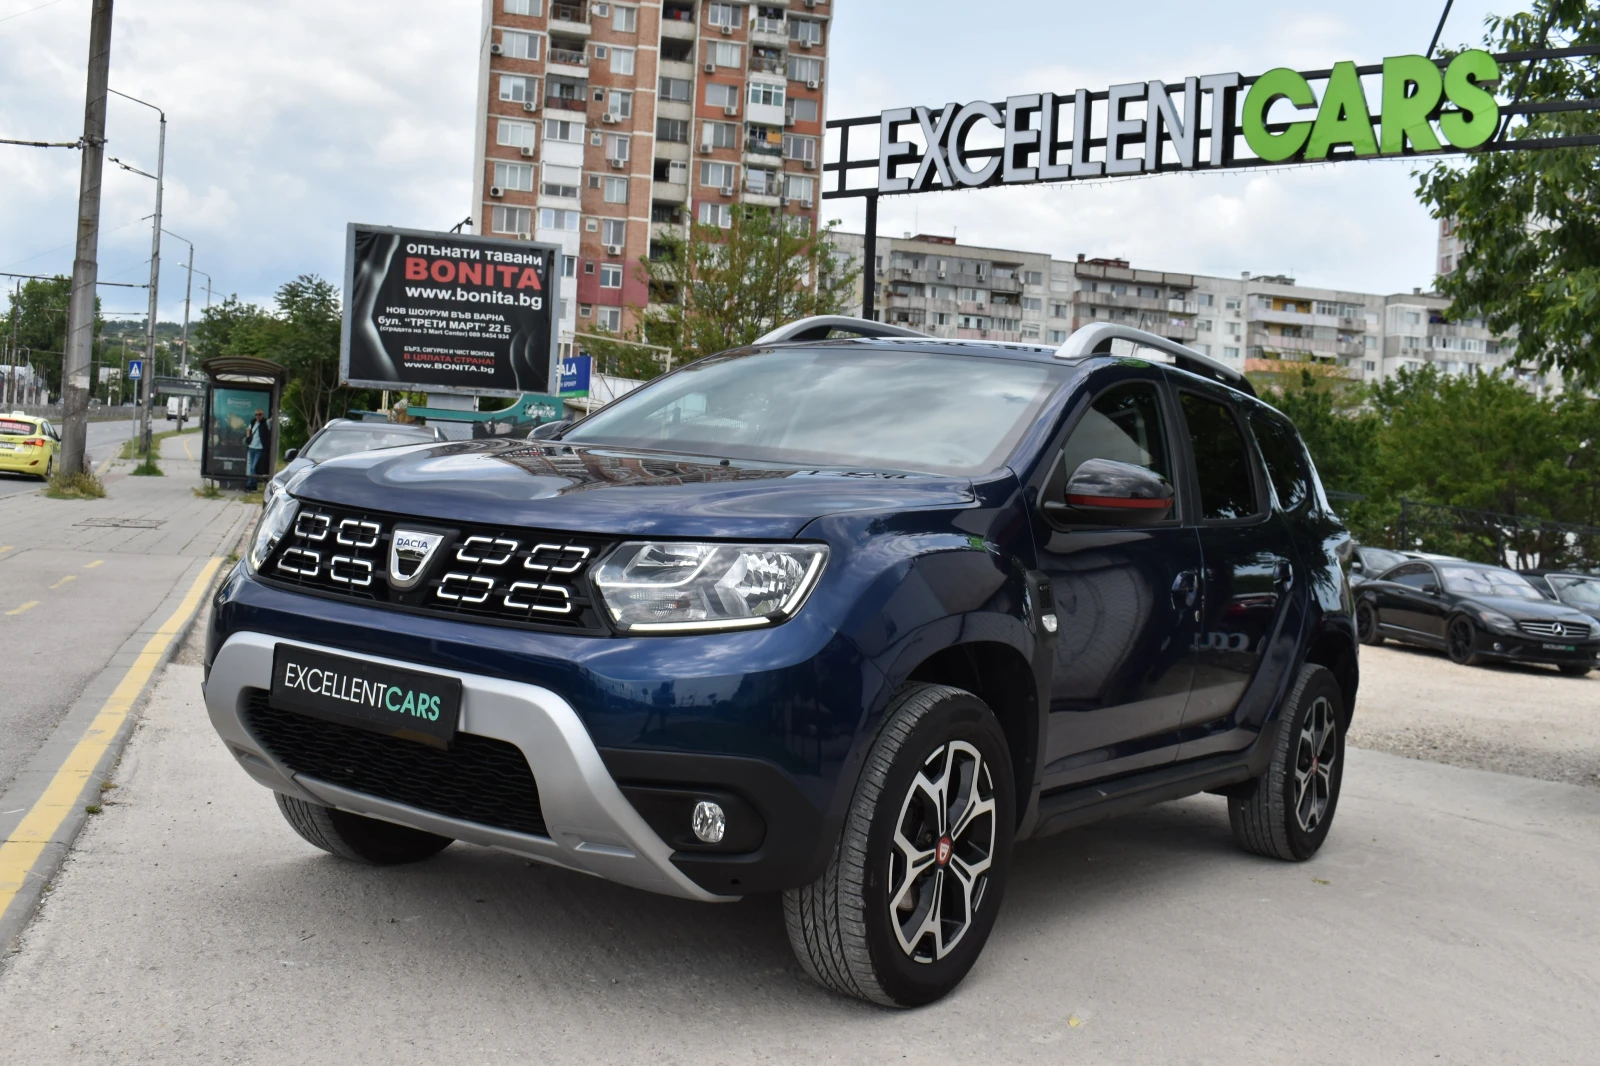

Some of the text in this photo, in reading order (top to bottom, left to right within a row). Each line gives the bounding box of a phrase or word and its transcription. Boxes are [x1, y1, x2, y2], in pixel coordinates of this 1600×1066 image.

[406, 243, 542, 266] опънати тавани
[405, 286, 542, 310] www.bonita.bg
[386, 306, 505, 322] НОВ ШОУРУМ ВЪВ ВАРНА
[378, 316, 402, 326] бул.
[488, 324, 502, 333] 22
[503, 325, 512, 333] Б
[380, 326, 412, 334] (сградата
[444, 330, 468, 338] Center)
[413, 354, 452, 363] ЦЯЛАТА
[453, 356, 495, 365] СТРАНА!
[404, 362, 495, 374] www.BONITA.bg
[396, 537, 428, 549] DACIA
[284, 663, 441, 721] EXCELLENTCARS
